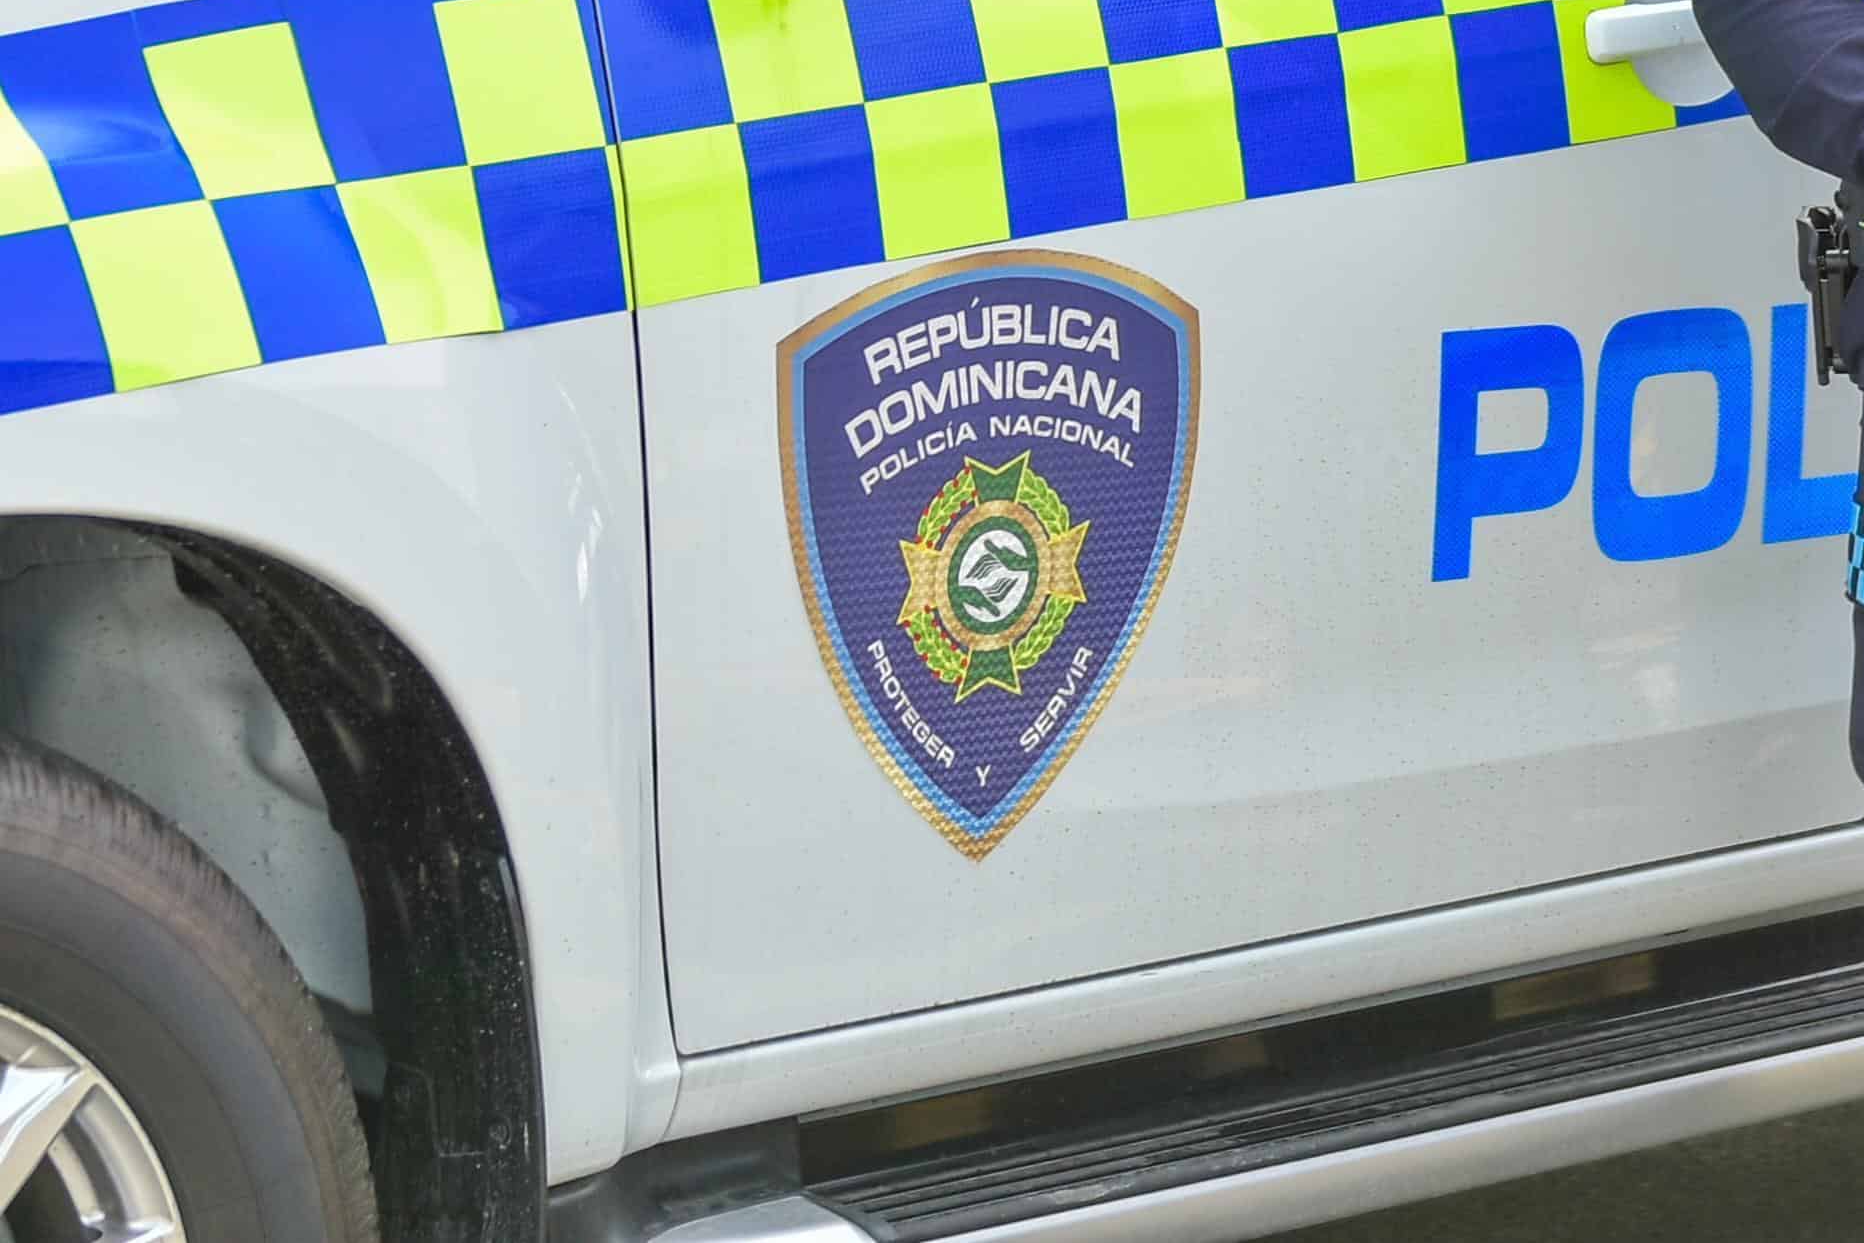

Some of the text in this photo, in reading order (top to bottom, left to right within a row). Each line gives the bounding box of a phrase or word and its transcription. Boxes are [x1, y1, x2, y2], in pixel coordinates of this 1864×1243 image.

[864, 297, 1120, 385] REPÚBLICA
[844, 360, 1142, 459] DOMINICANA
[859, 414, 1134, 496] POLICÍA NACIONAL
[867, 639, 1094, 787] PROTEGER Y SERVIR
